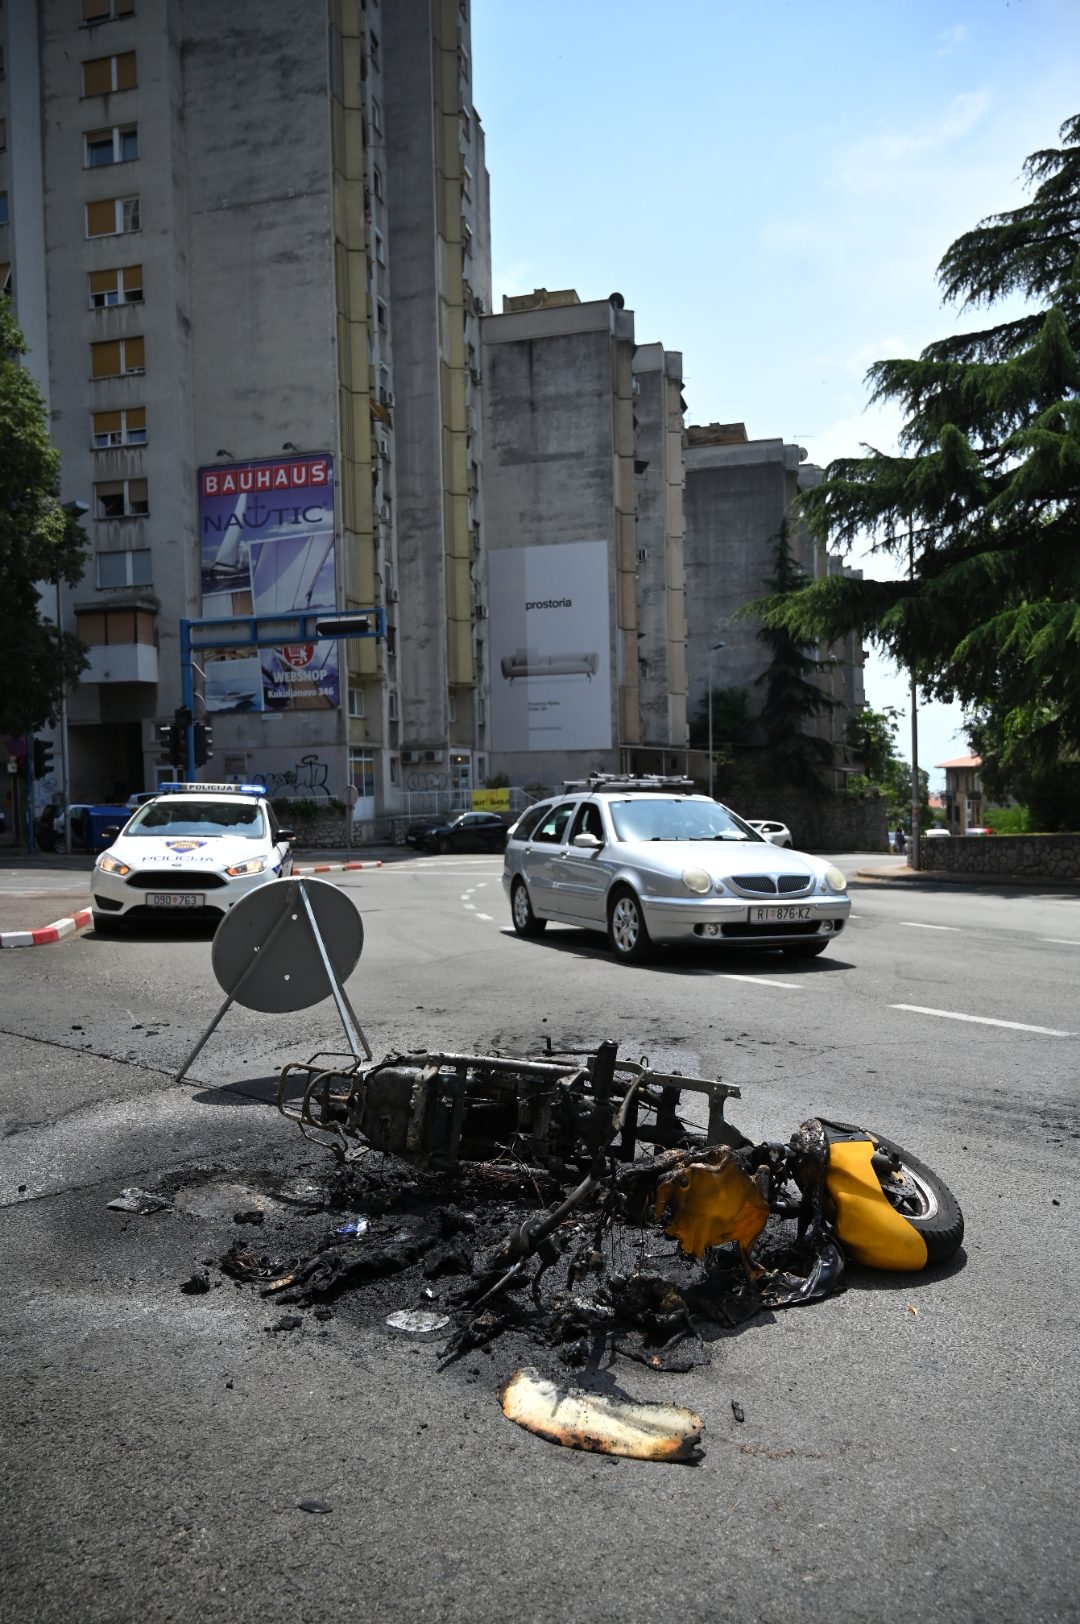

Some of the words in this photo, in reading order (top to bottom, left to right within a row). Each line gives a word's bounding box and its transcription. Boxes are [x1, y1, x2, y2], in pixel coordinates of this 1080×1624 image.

[206, 464, 325, 493] BAUHAUS
[525, 597, 572, 611] prostoria
[273, 669, 327, 683] WEBSHOP
[179, 895, 197, 905] 763
[757, 908, 768, 920] RI
